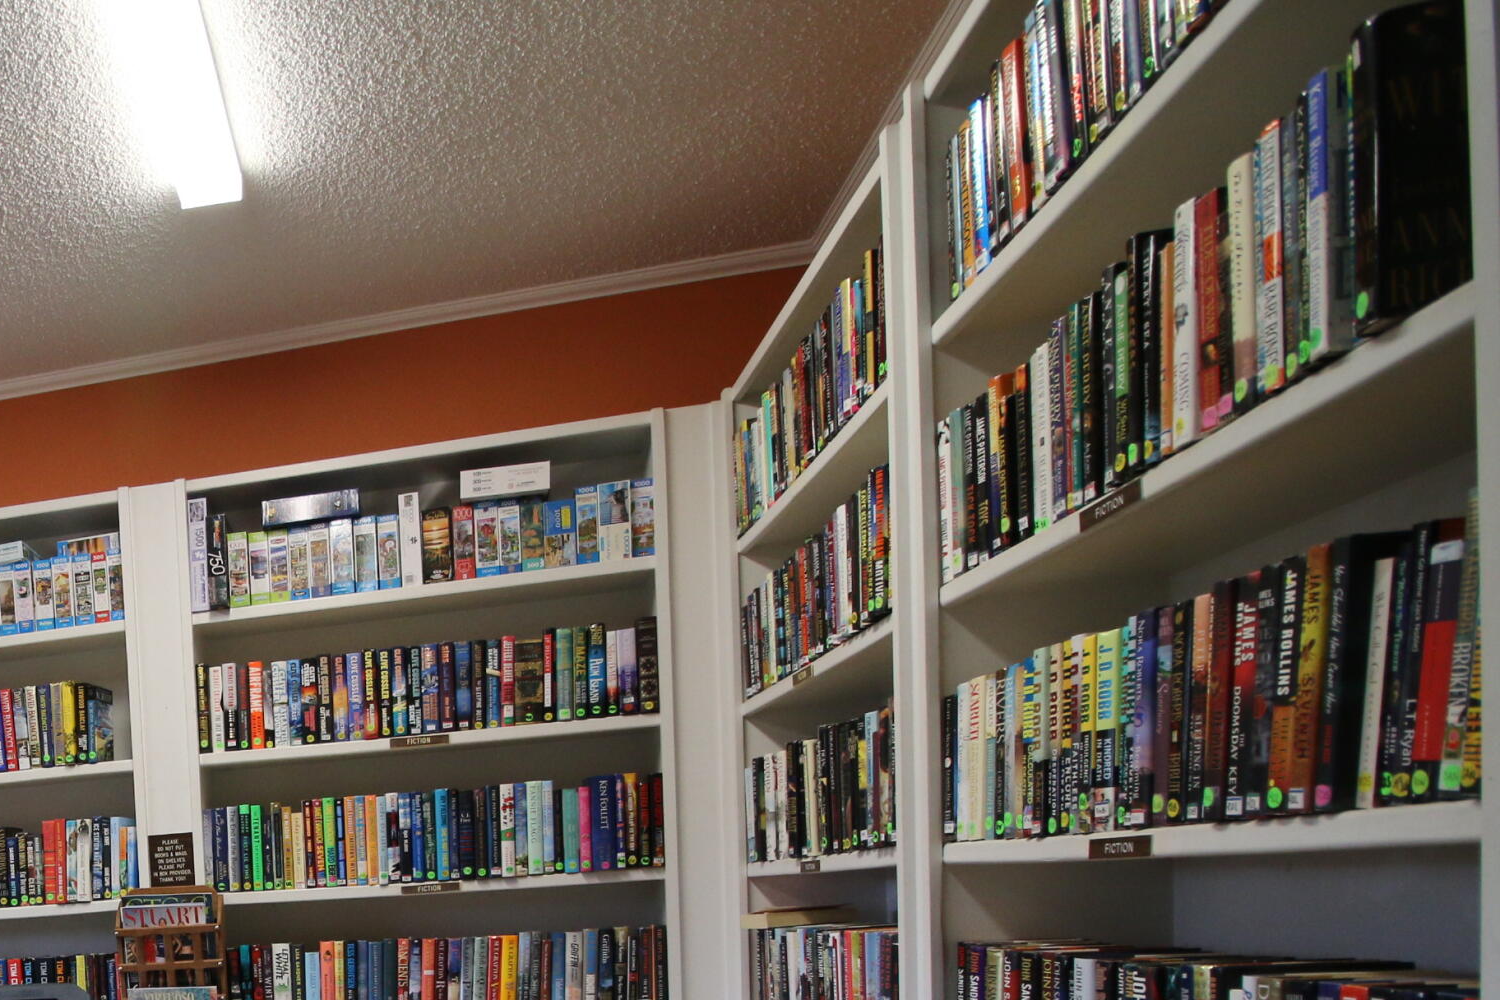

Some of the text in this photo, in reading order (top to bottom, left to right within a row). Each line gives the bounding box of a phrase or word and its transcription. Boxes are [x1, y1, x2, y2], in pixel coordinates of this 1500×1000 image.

[1178, 352, 1190, 412] COMING
[976, 417, 986, 484] JAMES PATTERSON
[979, 500, 988, 527] TOYS
[1095, 494, 1124, 519] FICTION
[209, 551, 226, 576] 750
[1307, 574, 1322, 625] JAMES
[1241, 605, 1256, 662] JAMES
[1277, 570, 1297, 696] JAMES ROLLINS
[577, 646, 587, 676] MAZE
[250, 668, 262, 712] AIRFRAME
[590, 679, 602, 702] ISLAND
[1098, 680, 1112, 720] ROBB
[3, 713, 13, 748] BALDACCI
[996, 678, 1005, 744] RIVERS
[1297, 677, 1313, 759] SEVENTH
[406, 737, 431, 745] FICTION
[1103, 738, 1111, 780] KINDRED
[1193, 715, 1202, 770] SLEEPING
[1228, 686, 1241, 795] DOOMSDAY KEY
[1401, 728, 1414, 767] Ryan
[599, 798, 609, 829] FOLLETT
[1104, 840, 1134, 855] FICTION
[398, 945, 407, 987] ANCIENTS
[987, 964, 996, 985] JOHN
[1022, 958, 1030, 981] JOHN
[1043, 959, 1052, 988] JOHN
